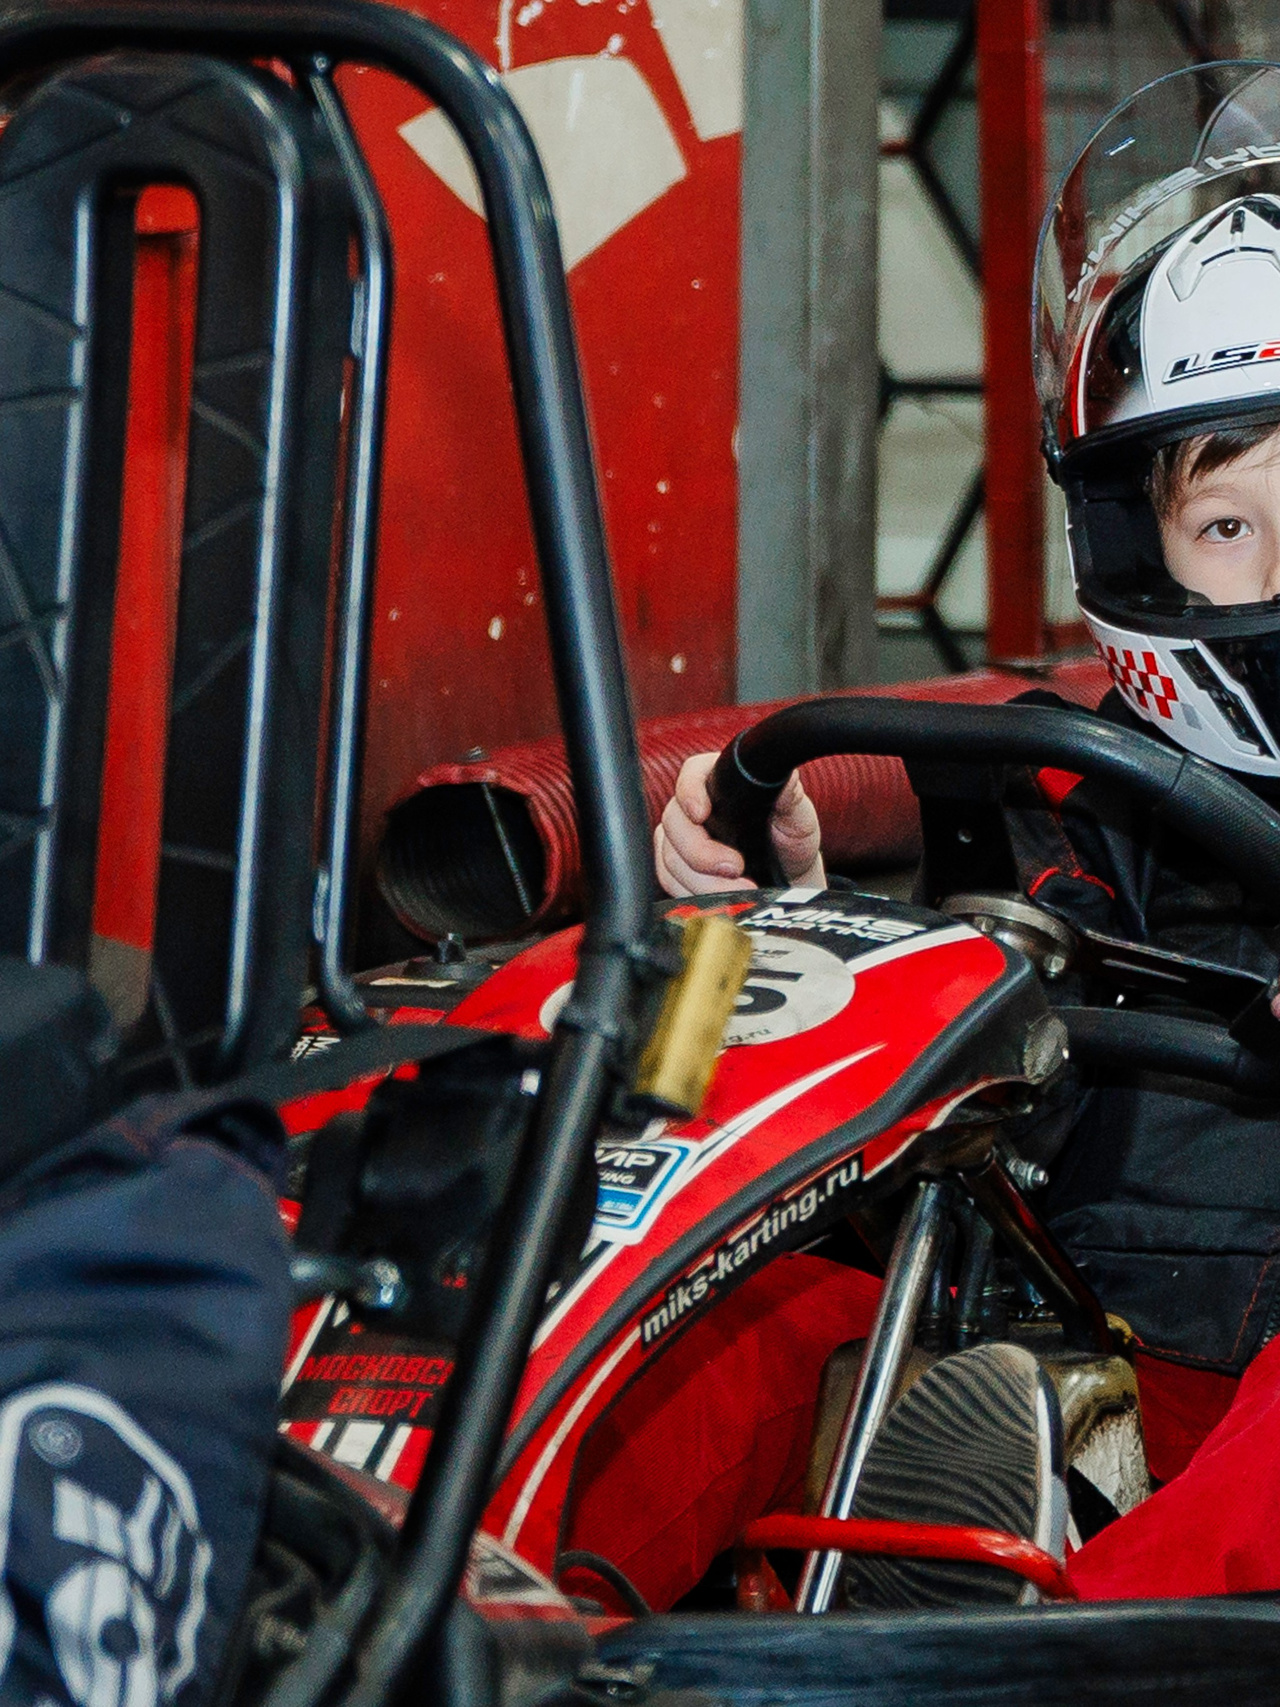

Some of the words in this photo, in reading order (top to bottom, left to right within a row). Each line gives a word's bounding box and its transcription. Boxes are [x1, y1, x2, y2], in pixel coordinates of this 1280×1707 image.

[737, 917, 901, 943] KARTING
[752, 907, 926, 936] MIKS
[644, 1160, 859, 1341] miks-karting.ru
[328, 1387, 434, 1419] СПОРТ
